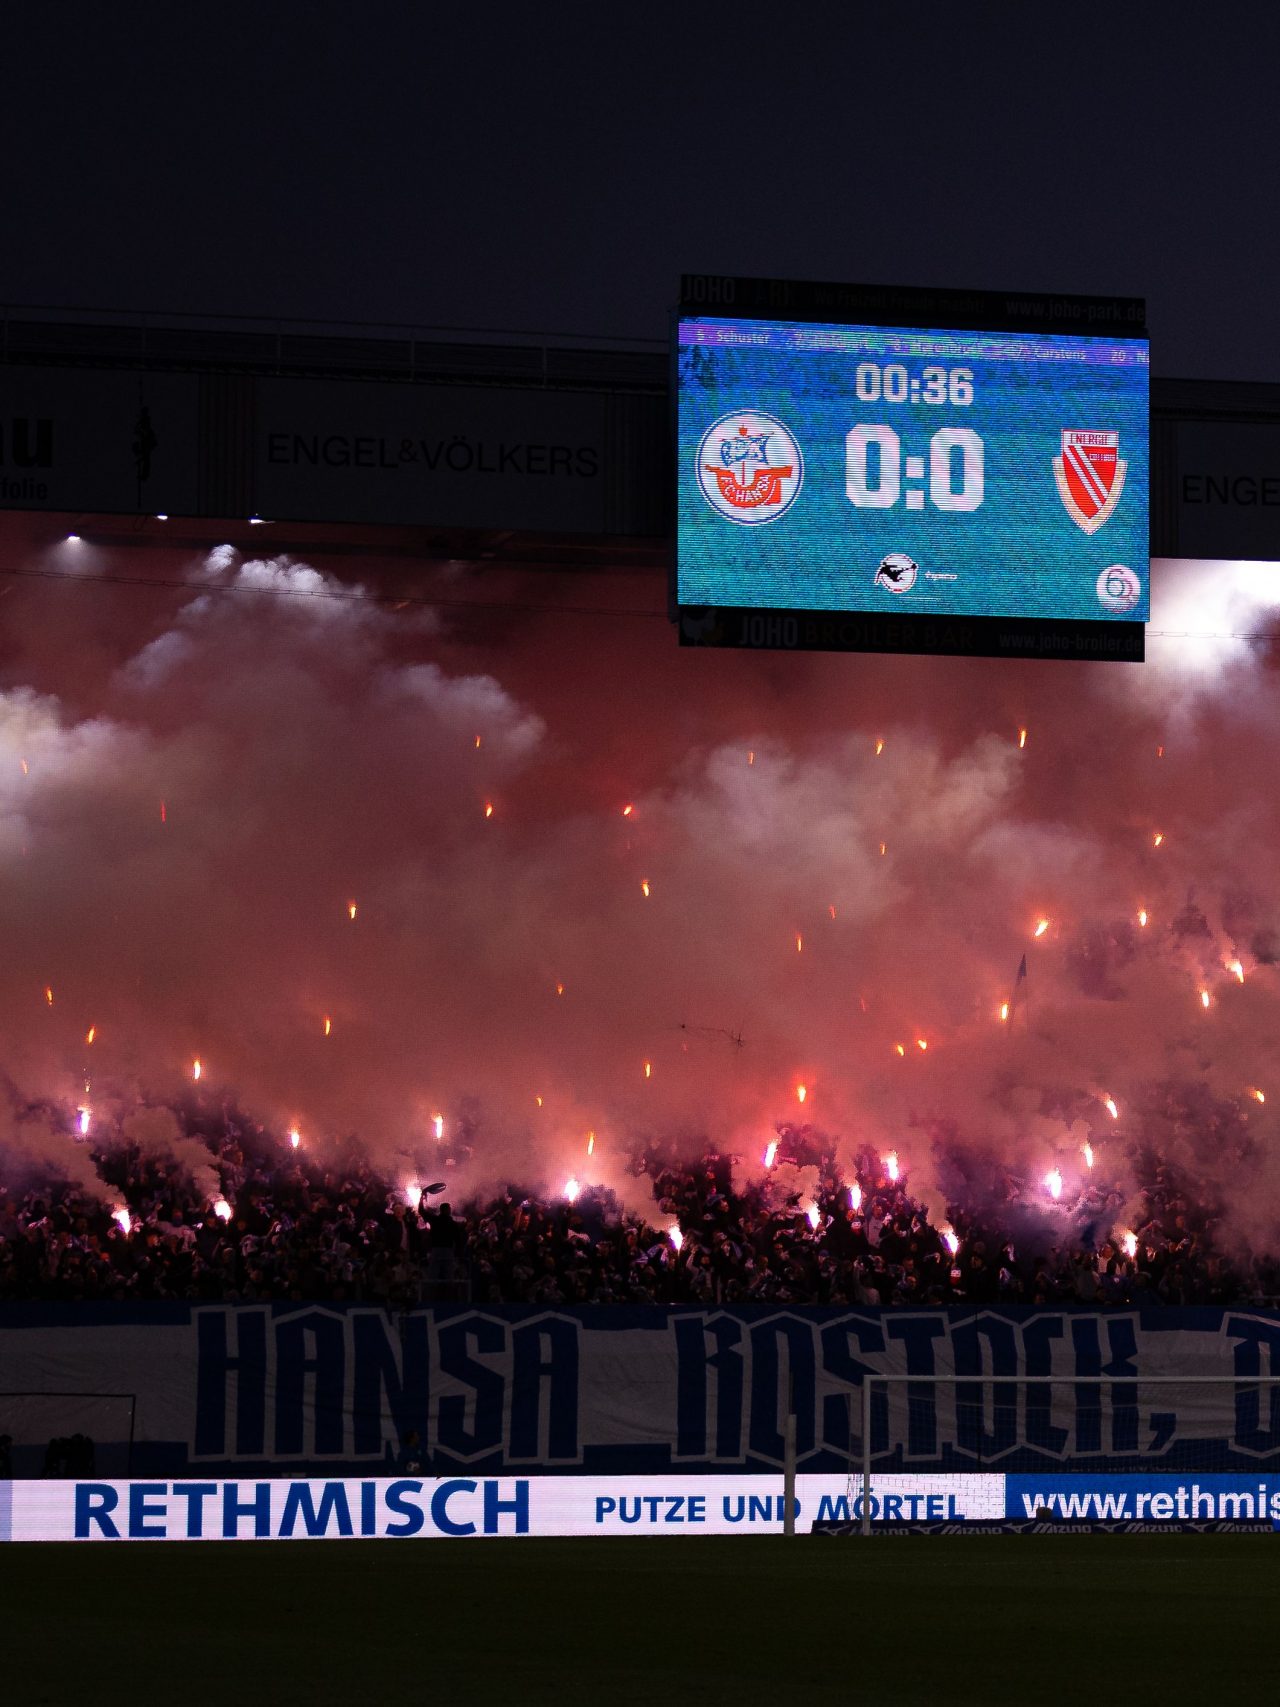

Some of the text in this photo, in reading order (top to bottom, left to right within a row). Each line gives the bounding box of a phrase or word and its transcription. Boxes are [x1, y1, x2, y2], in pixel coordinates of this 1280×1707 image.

[684, 276, 737, 304] JOHO
[1004, 298, 1146, 323] www.joho-park.de
[856, 362, 974, 407] 00:36
[0, 418, 53, 468] u
[268, 433, 599, 478] ENGEL&VÖLKERS
[845, 423, 985, 513] 0:0
[738, 614, 976, 650] JOHO BROILER BAR
[187, 1303, 585, 1467] HANSA
[667, 1309, 1180, 1468] ROSTOCK,
[74, 1479, 530, 1538] RETHMISCH
[595, 1486, 965, 1523] PUTZE UND MÖRTEL
